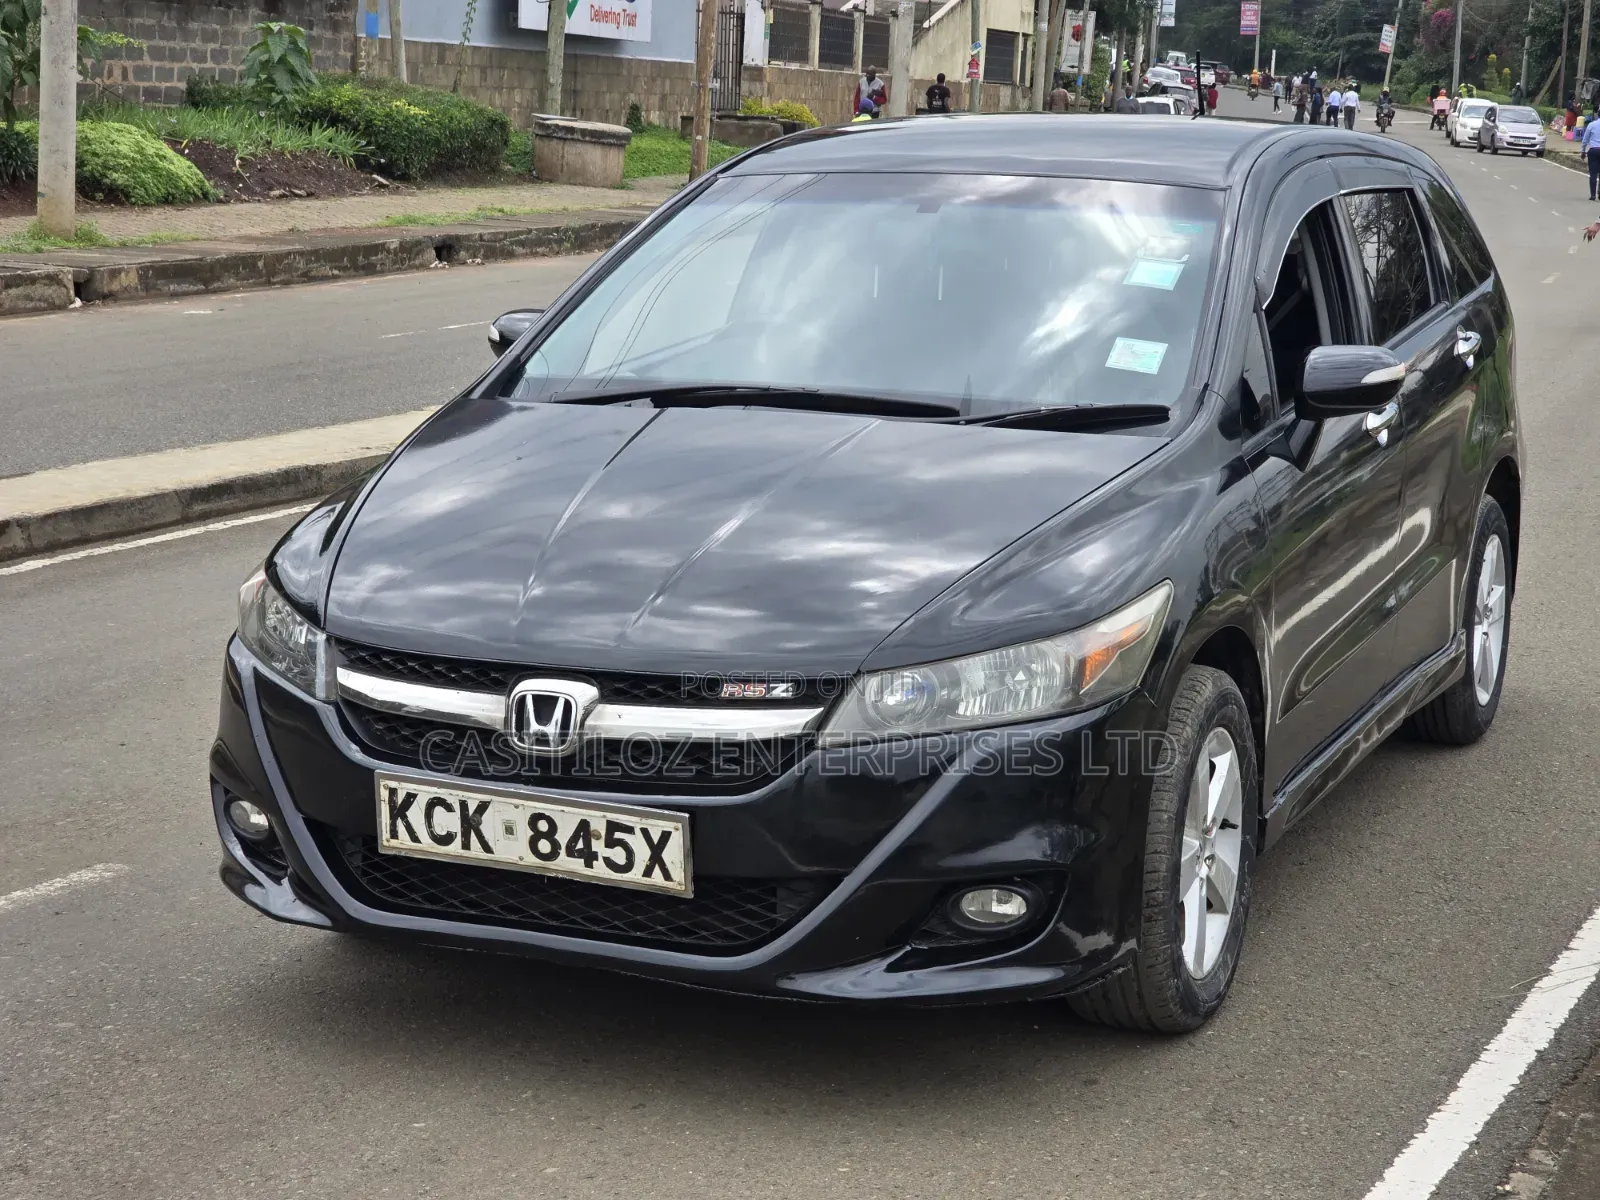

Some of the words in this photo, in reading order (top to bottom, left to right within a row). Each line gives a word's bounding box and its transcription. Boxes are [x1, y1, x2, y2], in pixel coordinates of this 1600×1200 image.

[590, 4, 620, 29] Delivering
[622, 9, 637, 27] Trust
[721, 682, 794, 698] RSZ
[388, 787, 495, 855] KCK
[528, 812, 674, 883] 845X
